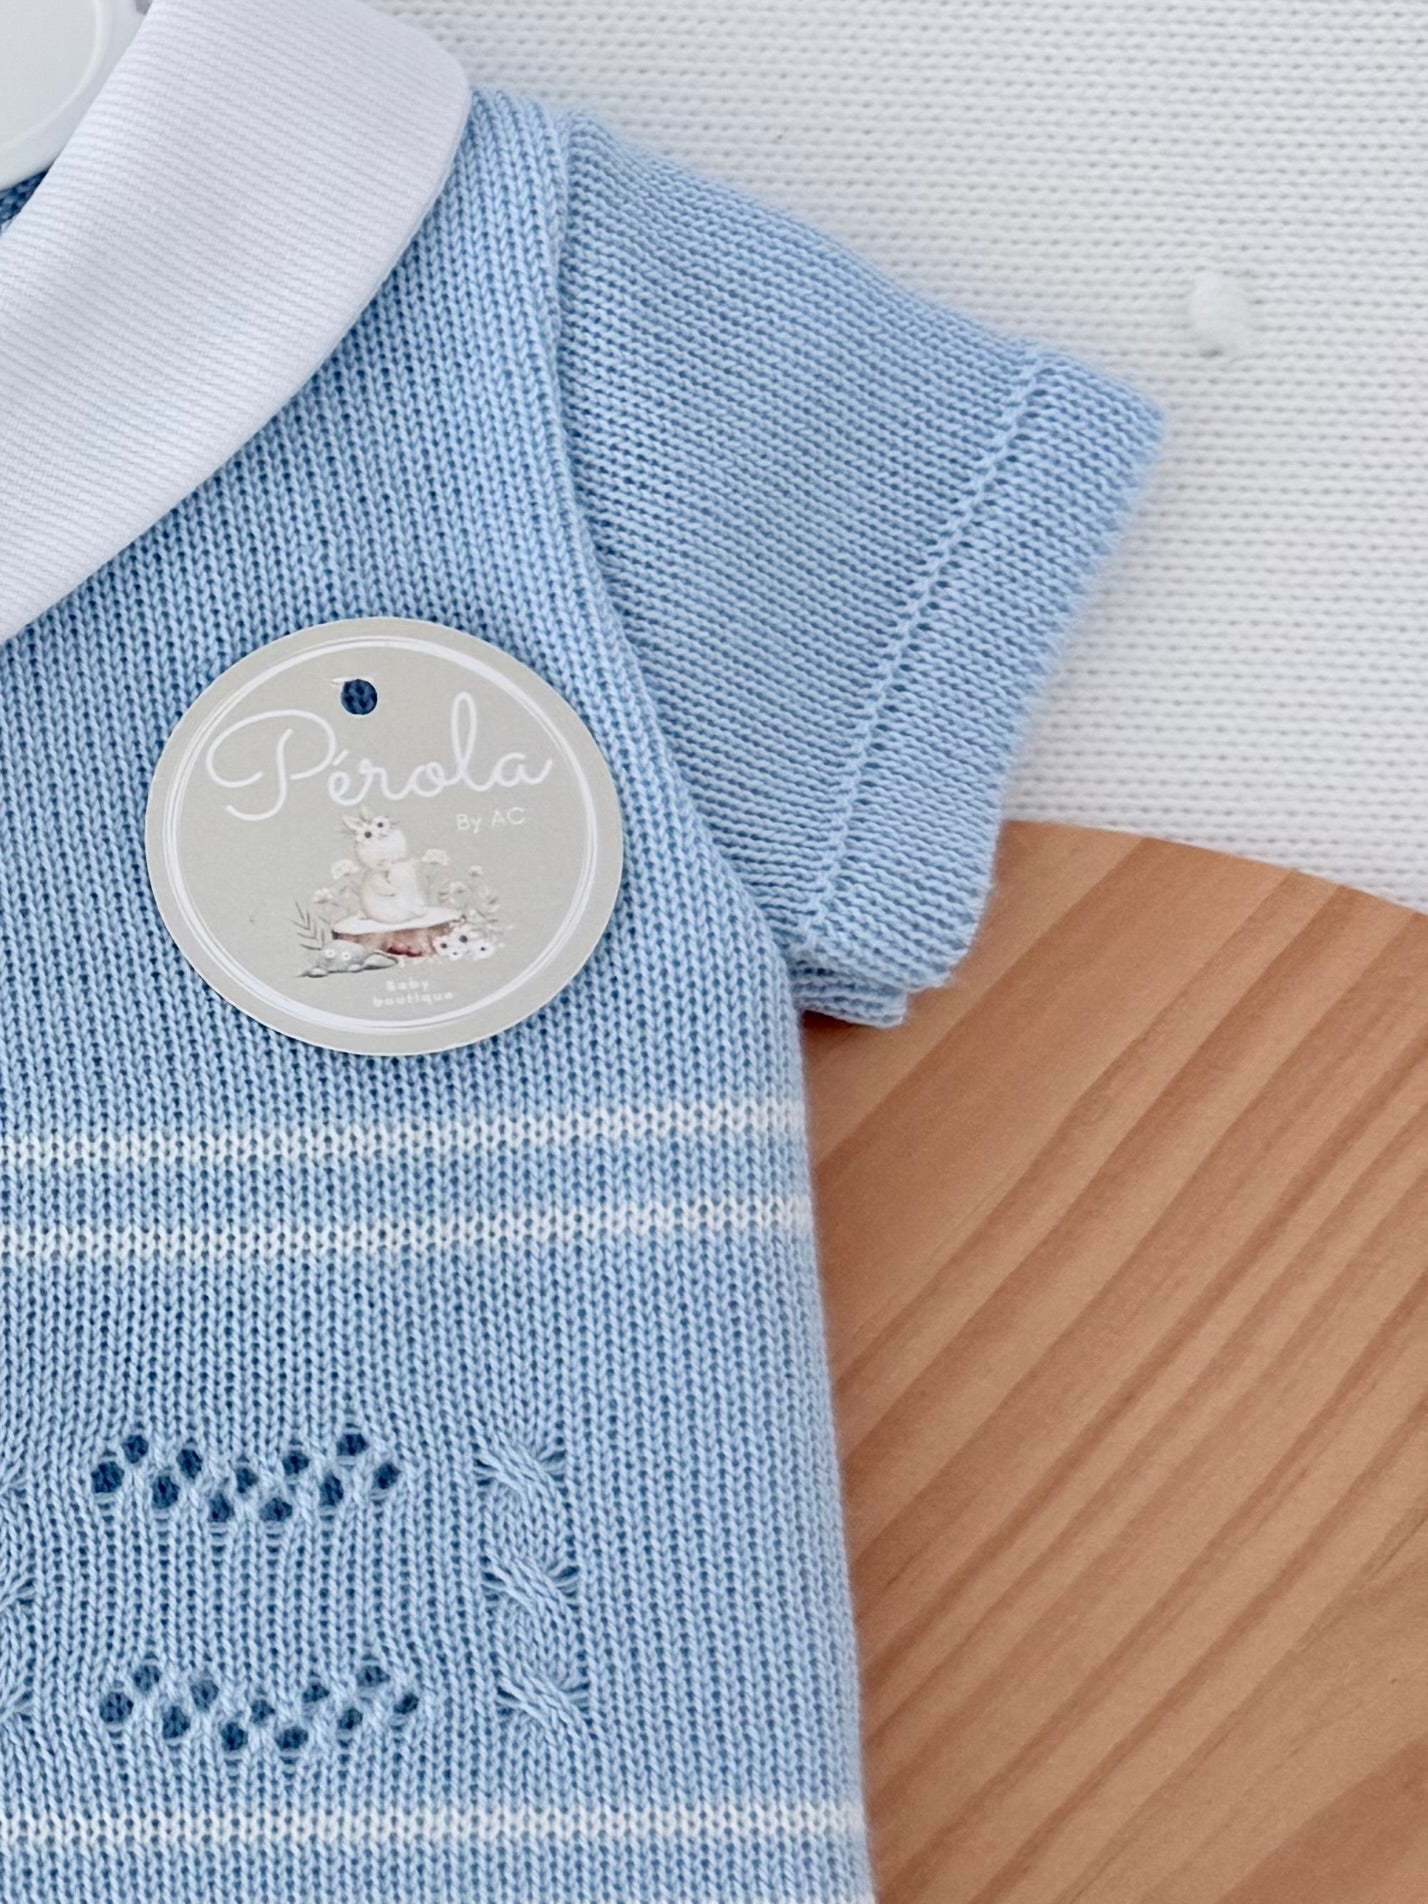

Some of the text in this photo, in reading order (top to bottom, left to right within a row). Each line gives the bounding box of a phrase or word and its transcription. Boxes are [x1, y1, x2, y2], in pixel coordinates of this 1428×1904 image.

[205, 691, 553, 822] Pérola
[456, 807, 526, 834] By AC
